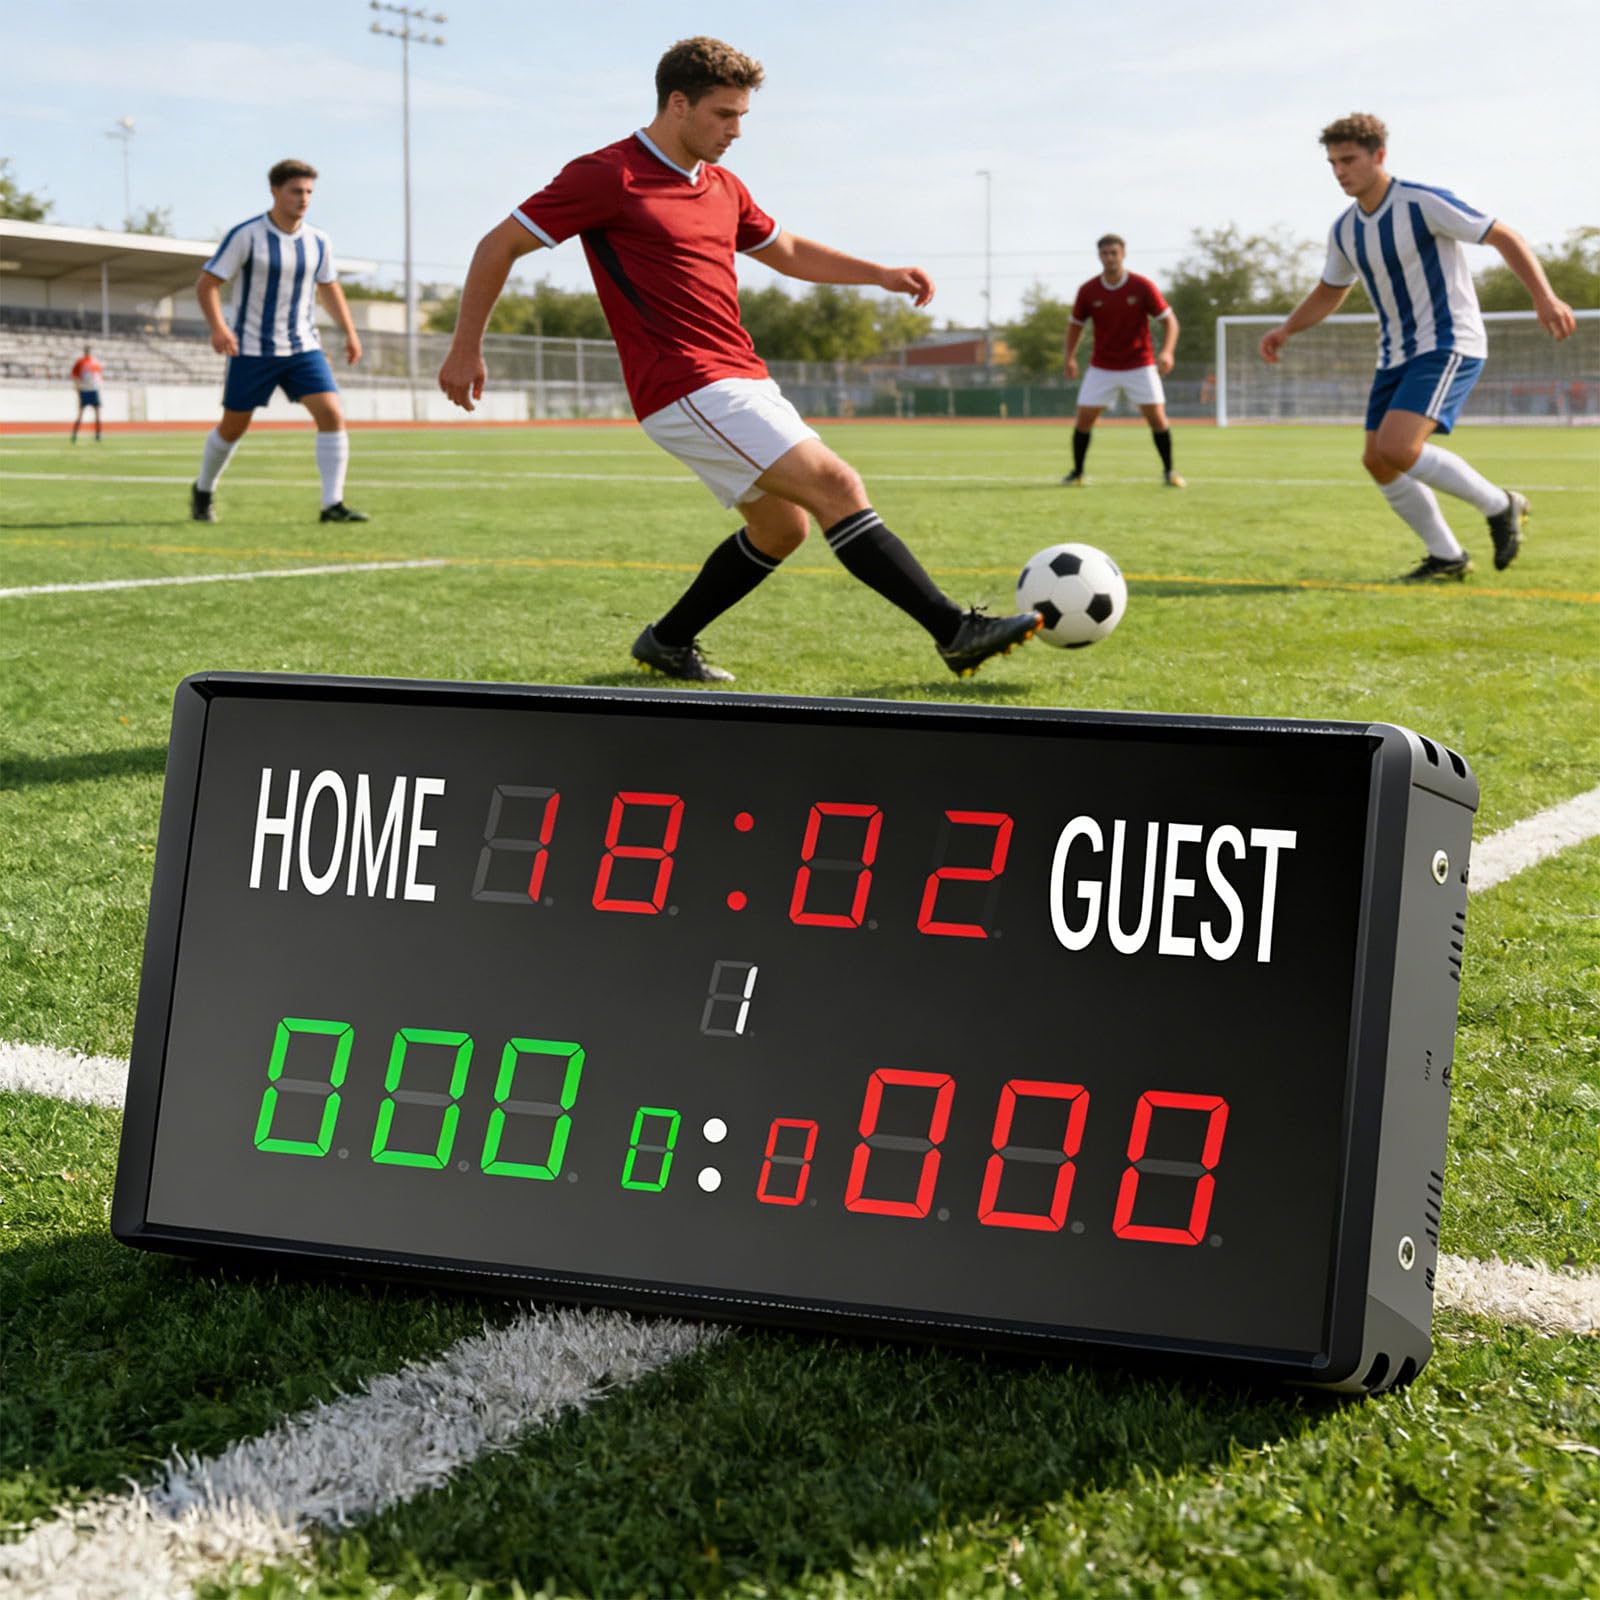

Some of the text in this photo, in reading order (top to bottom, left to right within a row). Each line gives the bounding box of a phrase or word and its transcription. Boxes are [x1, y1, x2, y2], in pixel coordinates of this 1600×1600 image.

[250, 768, 446, 902] HOME
[528, 791, 1014, 938] 18:02
[1051, 816, 1297, 963] GUEST
[735, 966, 758, 1035] 1
[254, 1017, 586, 1181] 000
[845, 1068, 1230, 1246] 000
